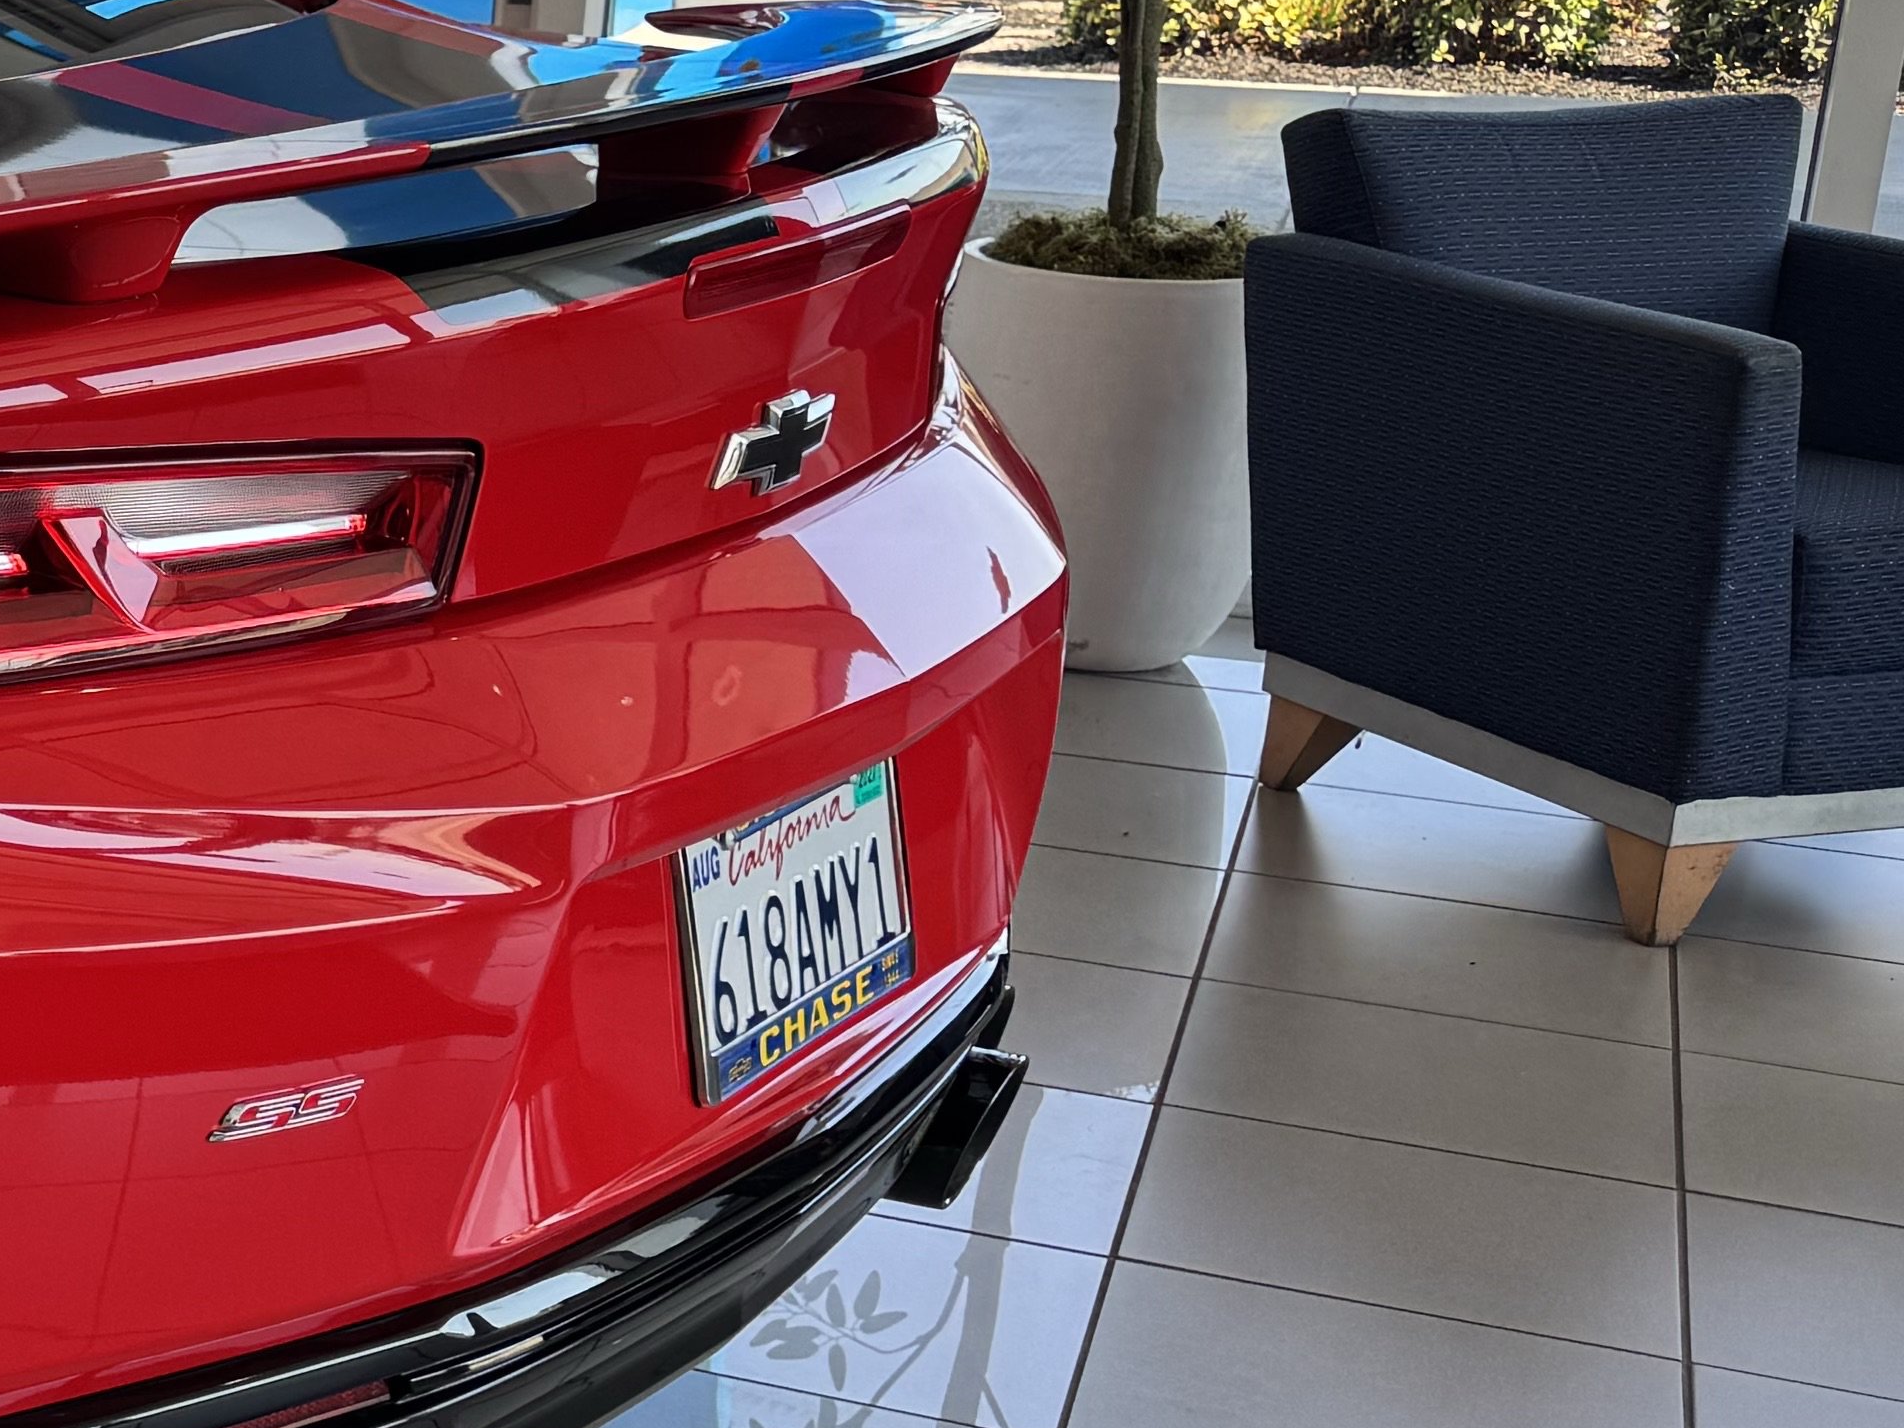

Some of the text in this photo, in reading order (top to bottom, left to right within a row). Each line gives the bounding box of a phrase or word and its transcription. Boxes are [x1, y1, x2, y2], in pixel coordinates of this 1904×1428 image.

[692, 845, 721, 893] AUG
[729, 795, 856, 886] California
[712, 834, 896, 1048] 618AMY1
[758, 965, 875, 1069] CHASE
[209, 1074, 365, 1142] SS
